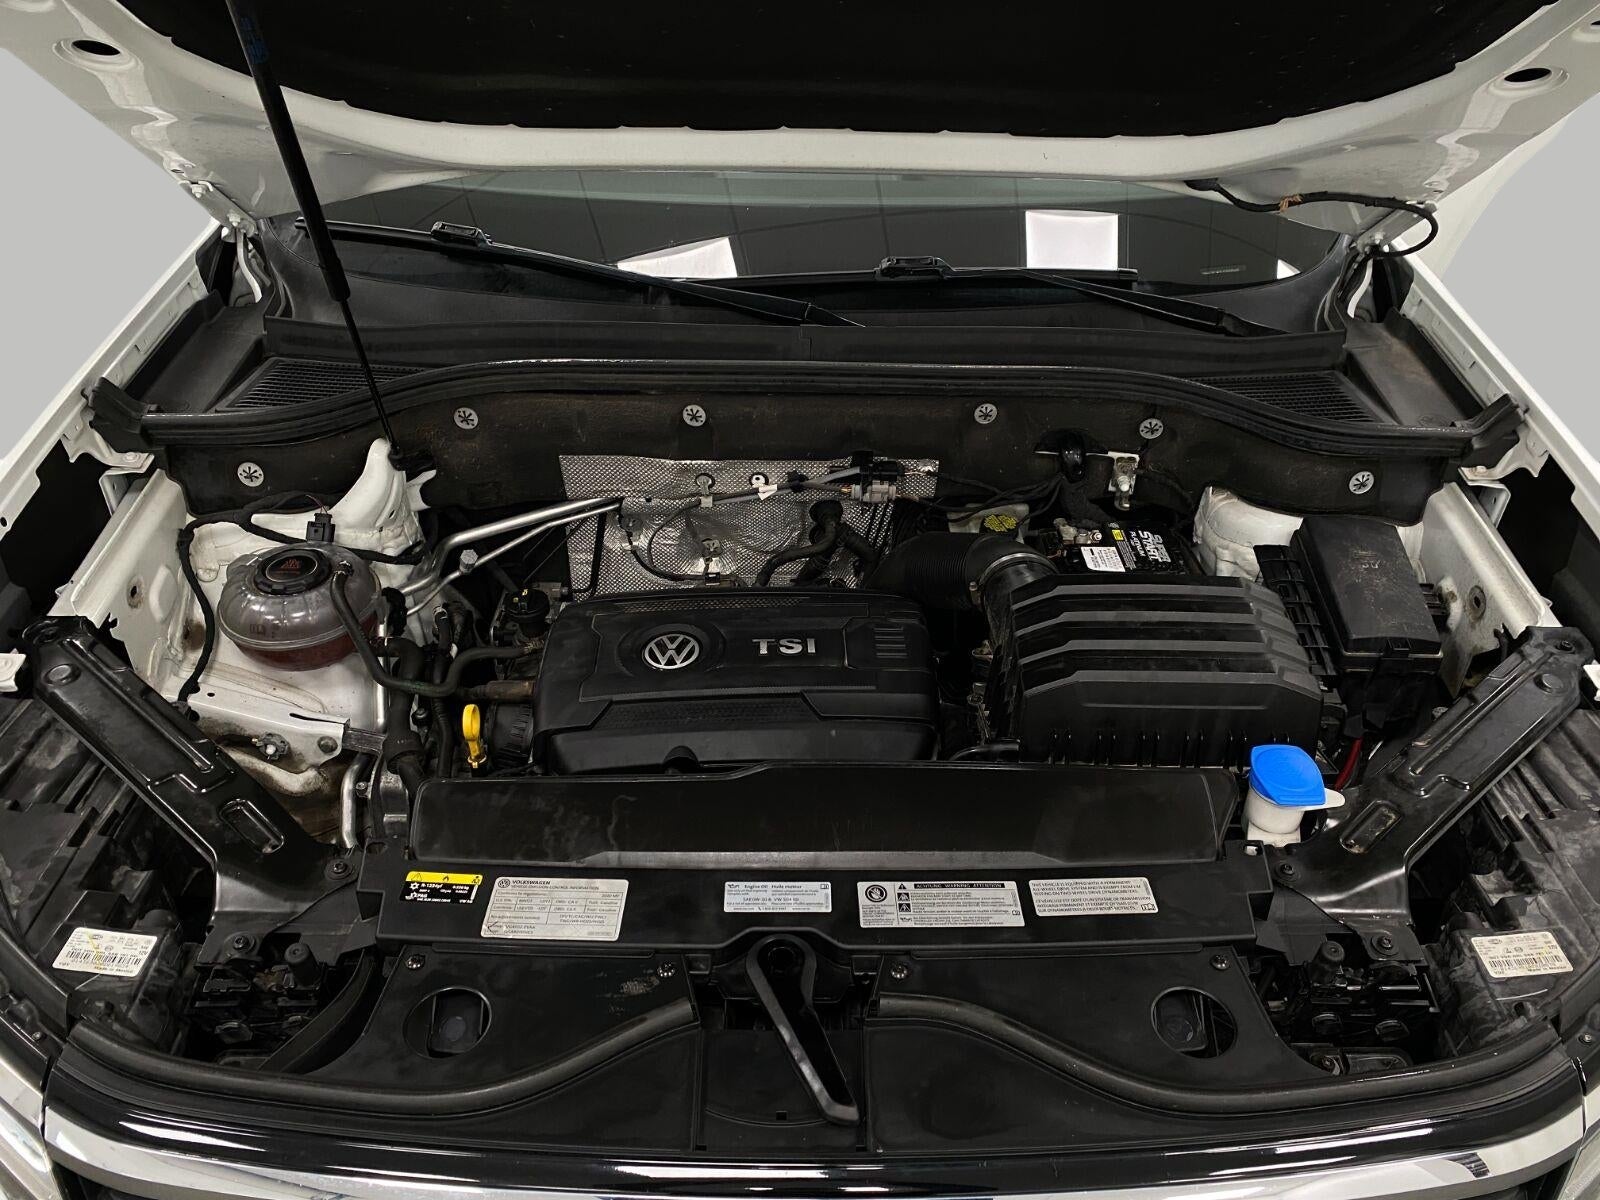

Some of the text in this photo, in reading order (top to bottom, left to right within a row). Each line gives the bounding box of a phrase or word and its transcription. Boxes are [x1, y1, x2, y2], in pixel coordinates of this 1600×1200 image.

[1129, 530, 1146, 557] PLATINUM
[1138, 530, 1162, 562] START
[1153, 534, 1171, 562] SUPER
[751, 638, 816, 655] TSI
